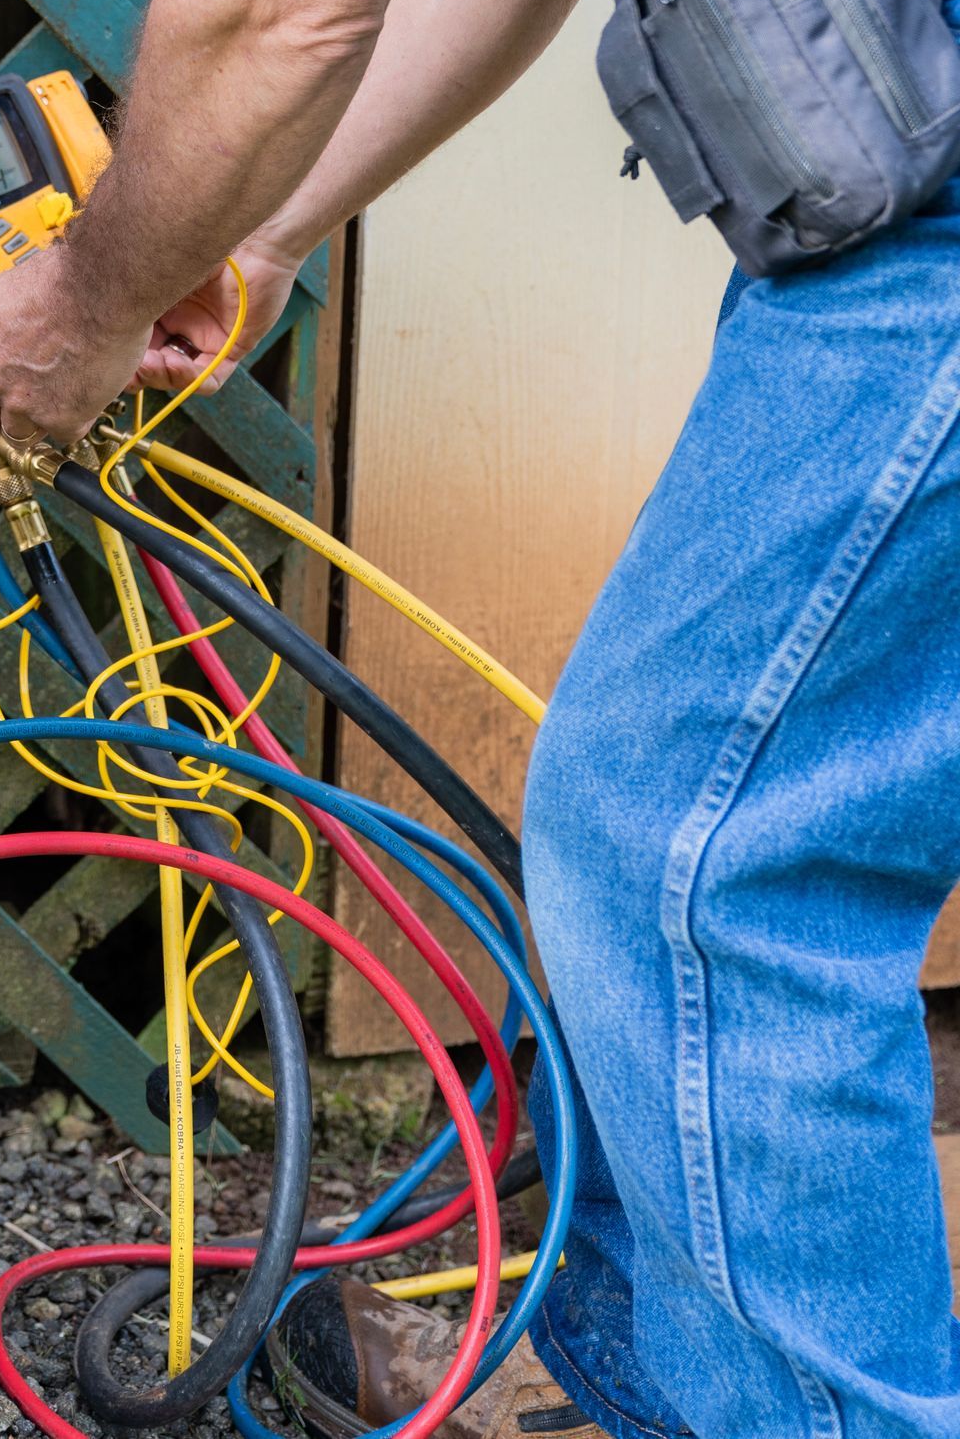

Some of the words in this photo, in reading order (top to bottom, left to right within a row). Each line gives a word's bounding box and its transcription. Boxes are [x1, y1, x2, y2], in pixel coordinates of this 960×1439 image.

[191, 469, 208, 483] USA
[112, 549, 125, 577] JB-Just
[121, 578, 131, 601] Better
[371, 577, 409, 609] CHARGING
[446, 634, 468, 653] Better
[466, 650, 494, 674] JB-Just
[173, 1042, 182, 1078] JB-Just
[175, 1079, 183, 1108] Better
[177, 1162, 185, 1215] CHARGING
[177, 1217, 185, 1244] HOSE
[177, 1253, 185, 1273] 4000
[177, 1275, 185, 1290] PSI
[176, 1291, 185, 1319] BURST
[175, 1334, 183, 1347] PSI
